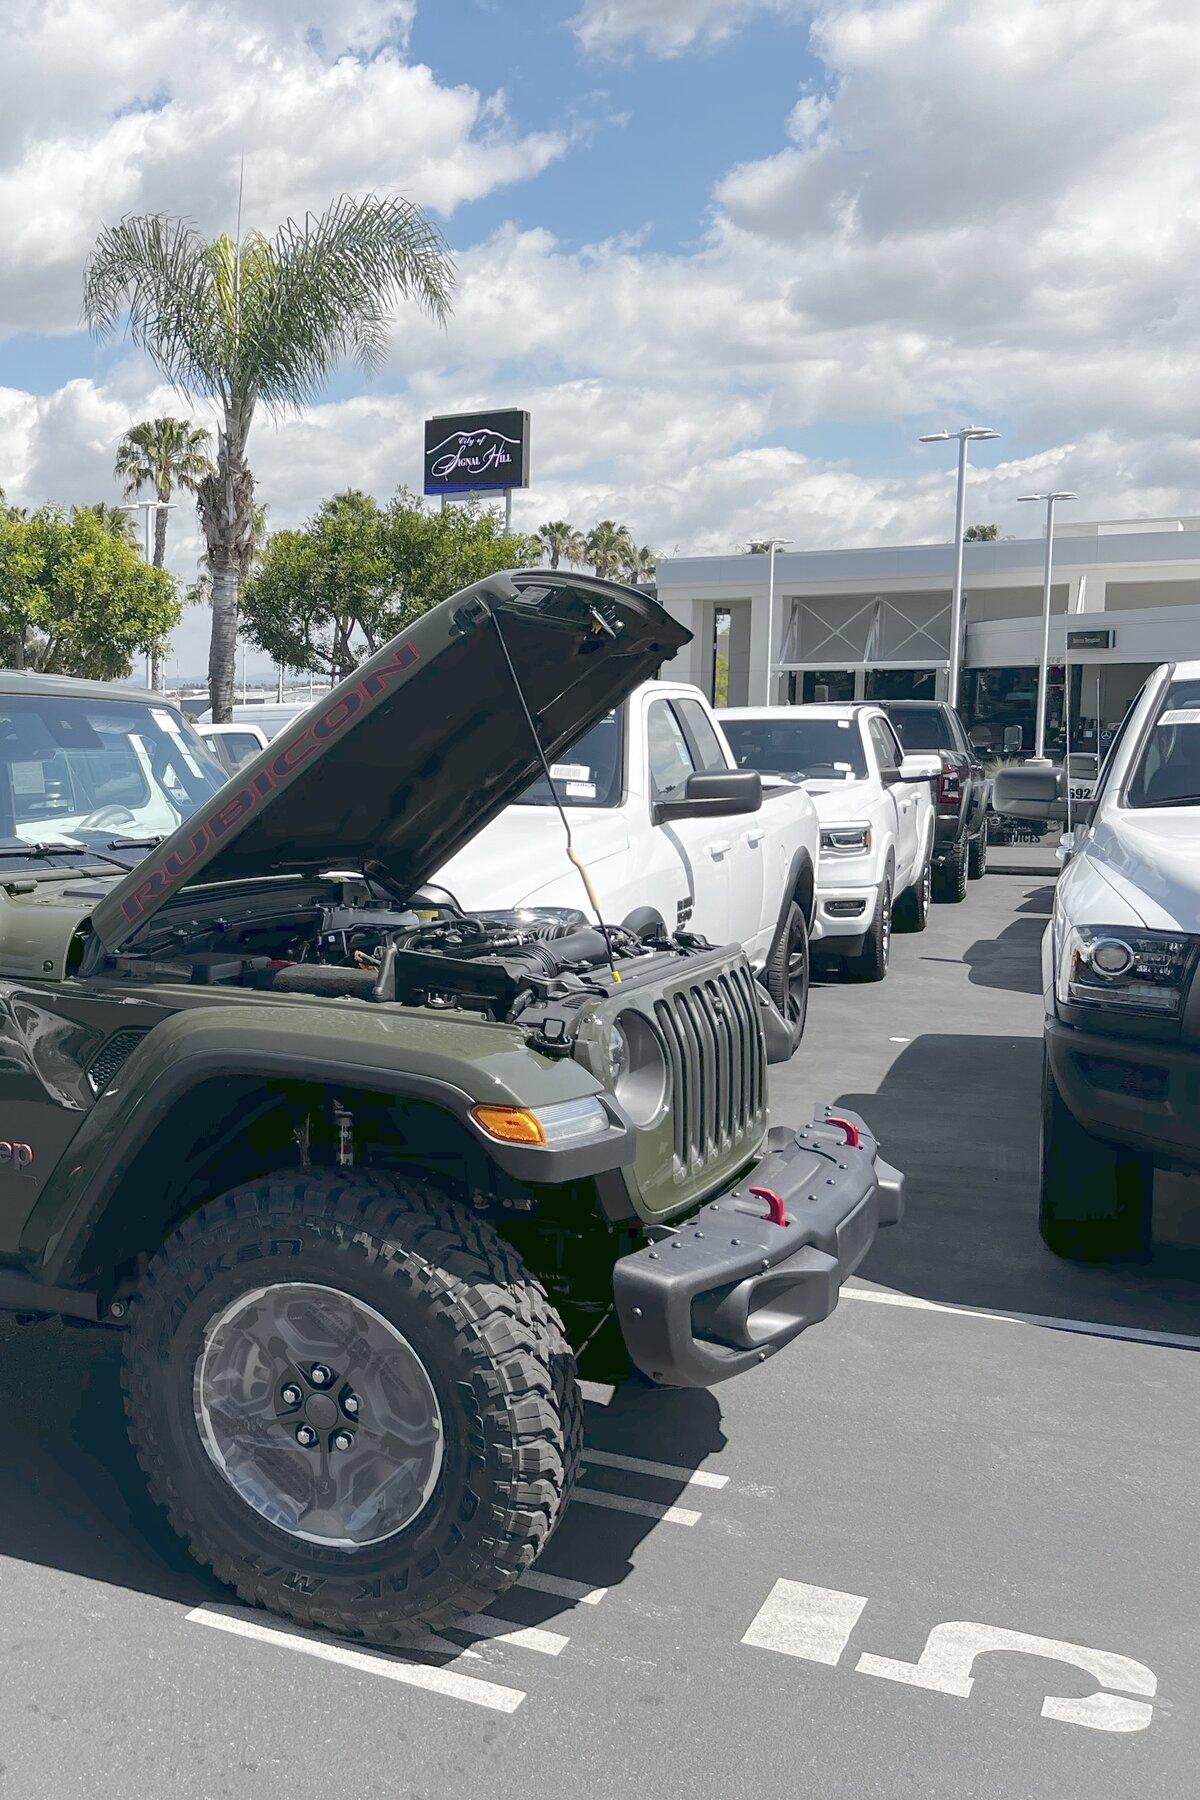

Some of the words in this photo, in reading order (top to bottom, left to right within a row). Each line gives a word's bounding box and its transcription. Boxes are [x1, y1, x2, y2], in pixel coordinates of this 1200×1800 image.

[457, 436, 475, 447] City
[476, 434, 488, 446] of
[118, 640, 422, 924] RUBICON
